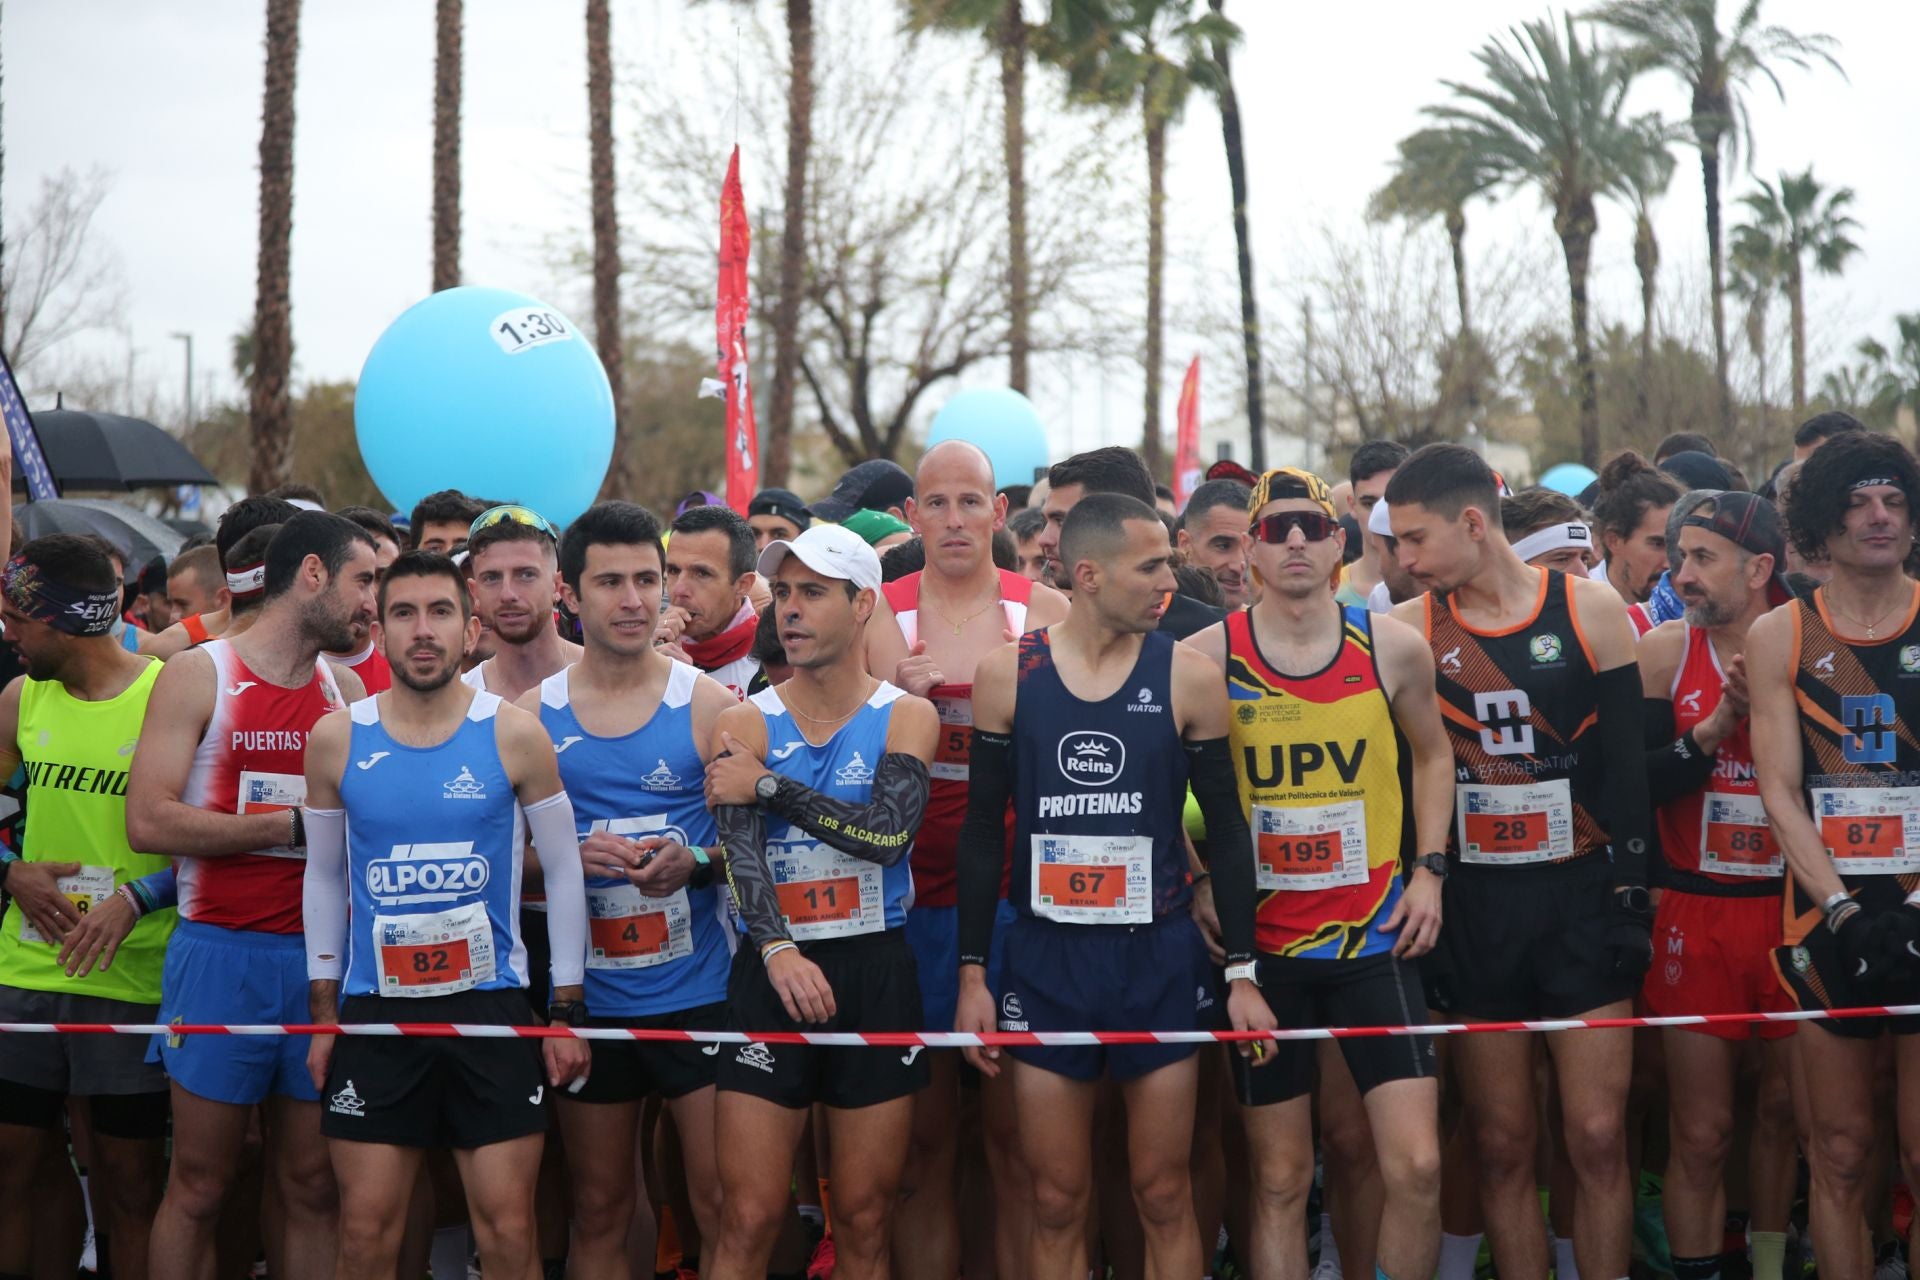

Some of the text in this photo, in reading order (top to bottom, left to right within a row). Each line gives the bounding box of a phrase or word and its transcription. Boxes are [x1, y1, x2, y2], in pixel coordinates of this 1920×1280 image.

[500, 313, 565, 344] 1:30
[1127, 704, 1162, 713] VIATOR
[232, 731, 301, 751] PUERTAS
[1067, 757, 1114, 774] Reina
[1244, 739, 1367, 788] UPV
[1039, 792, 1142, 818] PROTEINAS
[818, 815, 909, 847] LOS ALCAZARES
[1493, 820, 1527, 841] 28
[1731, 831, 1764, 851] 86
[1847, 823, 1882, 844] 87
[1279, 840, 1331, 861] 195
[1069, 871, 1105, 893] 67
[804, 886, 836, 909] 11
[622, 923, 639, 943] 4
[413, 950, 449, 972] 82
